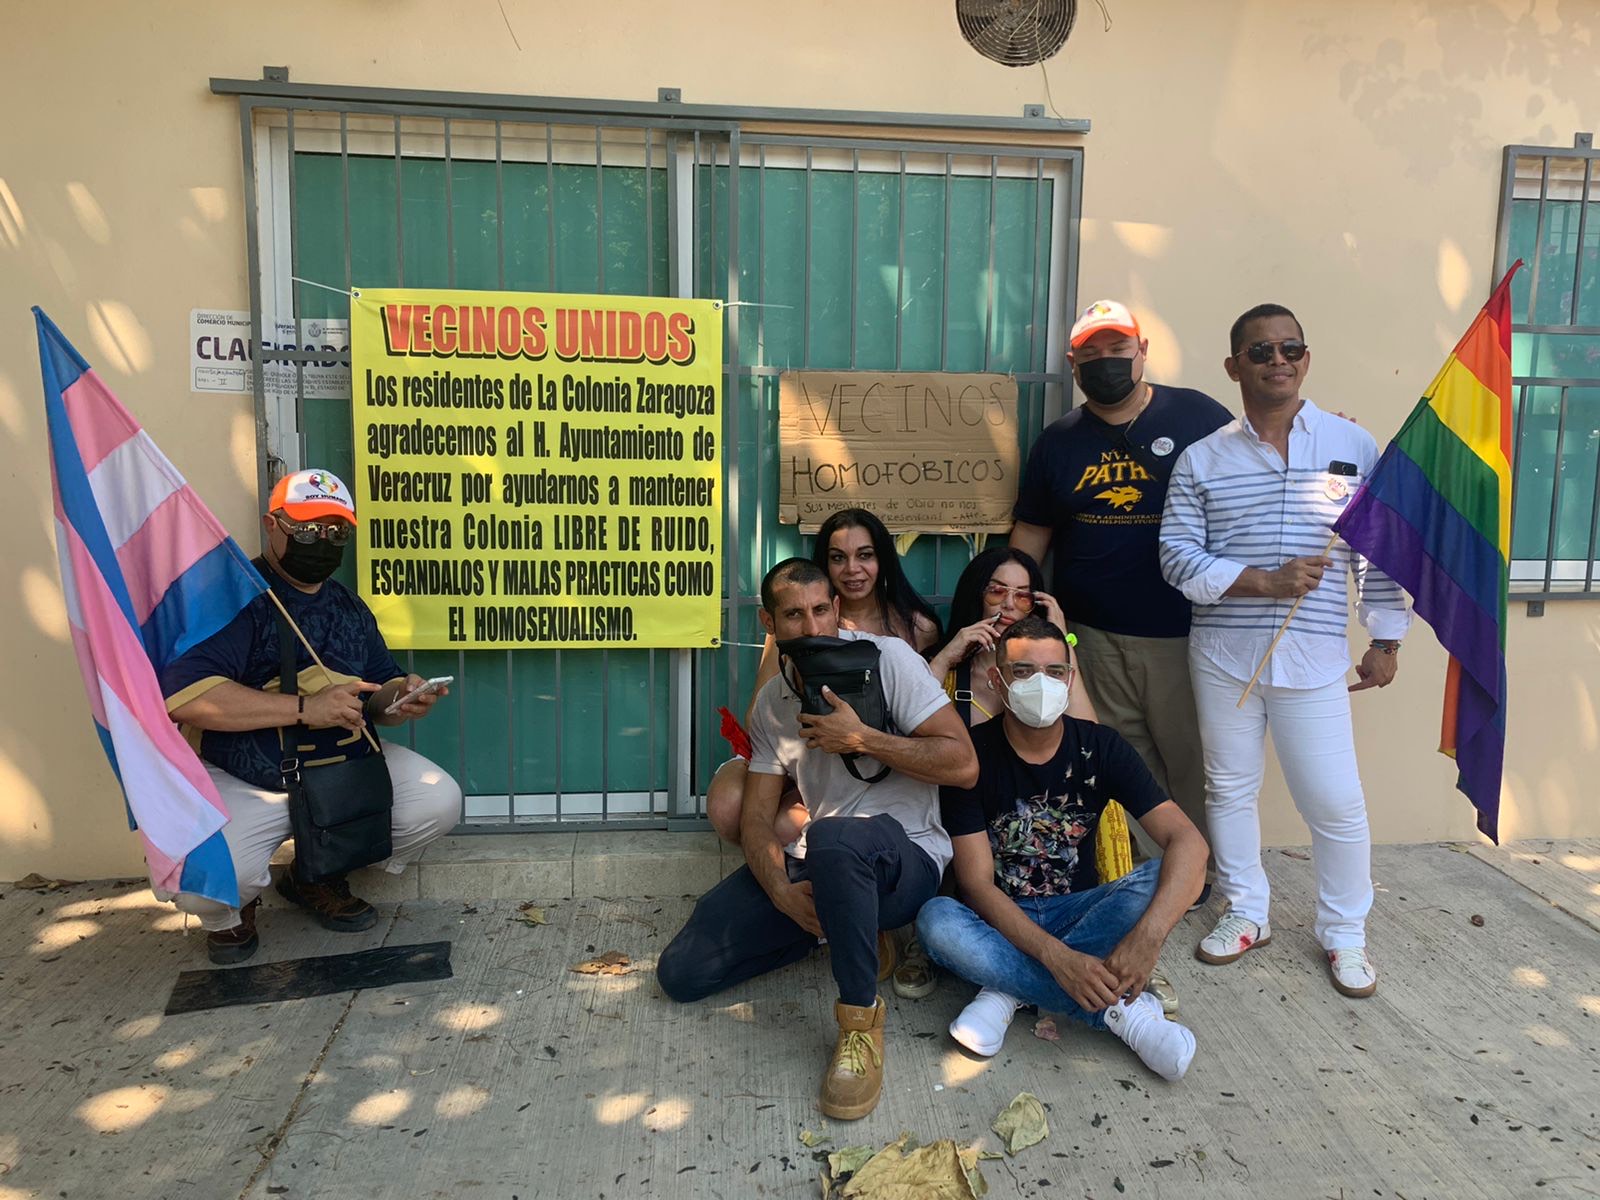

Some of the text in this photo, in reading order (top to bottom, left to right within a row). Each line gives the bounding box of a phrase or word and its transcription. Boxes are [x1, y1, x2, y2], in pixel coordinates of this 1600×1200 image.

[380, 304, 696, 366] VECINOS UNIDOS
[367, 369, 715, 419] Los residentes de La Colonia Zaragoza
[802, 381, 1006, 436] VECINOS
[368, 419, 715, 463] agradecemos al H. Ayuntamiento de
[368, 465, 715, 508] Veracruz por ayudarnos a mantener
[792, 453, 1005, 498] HOMOFÓBICOS
[370, 513, 714, 555] nuestra Colonia LIBRE DE RUIDO,
[371, 559, 714, 597] ESCANDALOS Y MALAS PRACTICAS COMO
[448, 606, 638, 643] EL HOMOSEXUALISMO.
